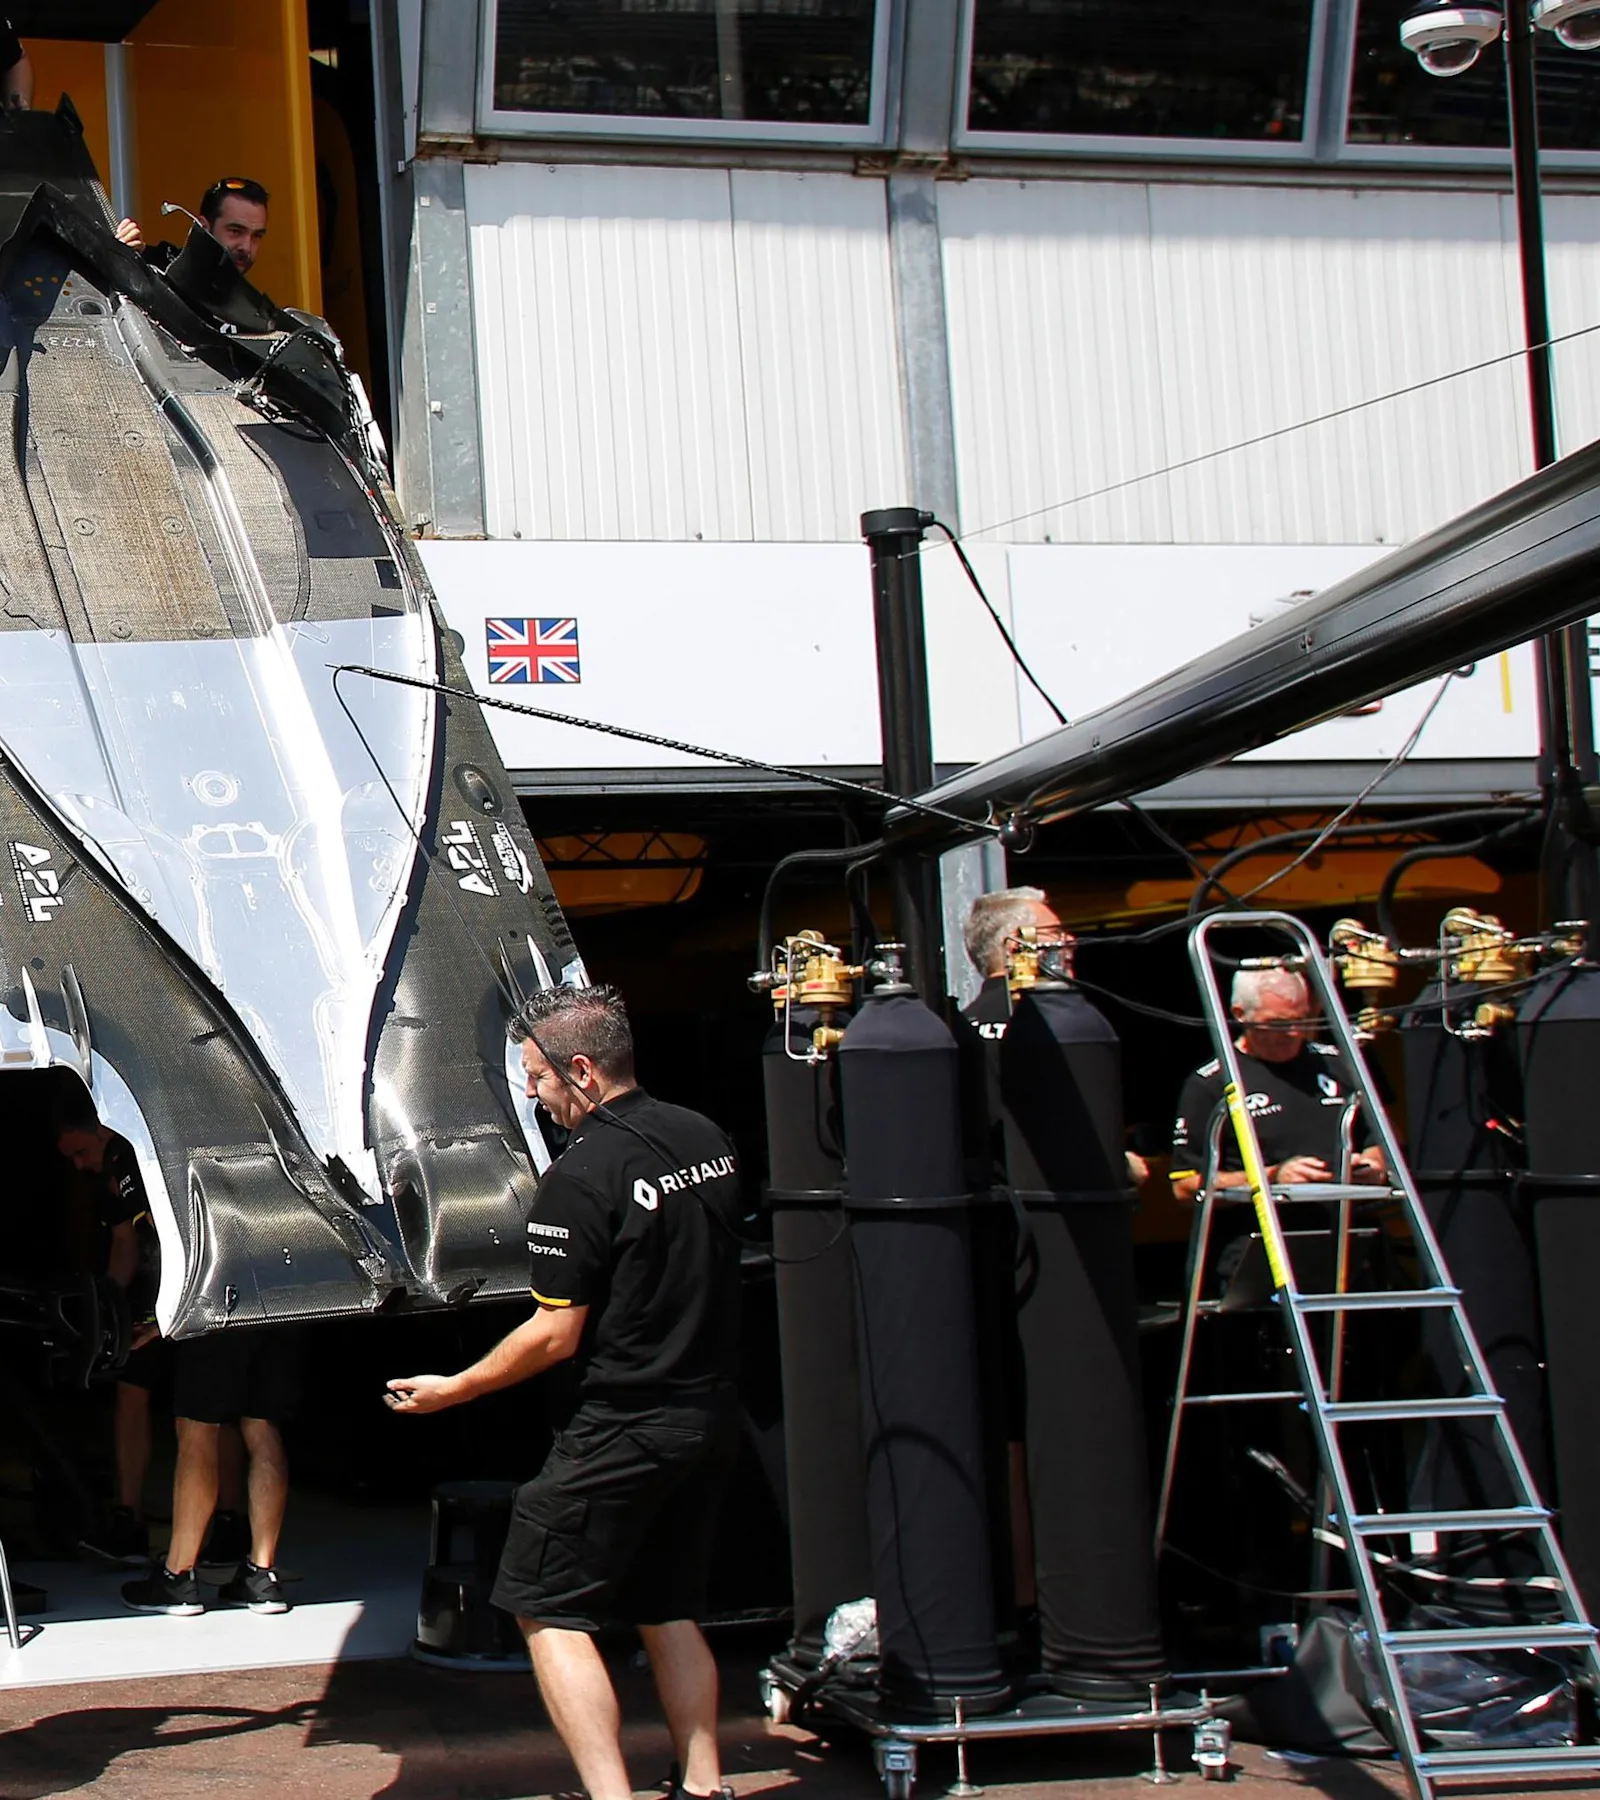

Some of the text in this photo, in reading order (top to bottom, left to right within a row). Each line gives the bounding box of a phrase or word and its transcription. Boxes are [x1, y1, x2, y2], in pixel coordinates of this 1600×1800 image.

[441, 820, 495, 897] APL
[13, 841, 64, 922] APL
[658, 1154, 735, 1195] RENAUL
[527, 1221, 570, 1240] PIRELLI
[527, 1241, 568, 1258] TOTAL
